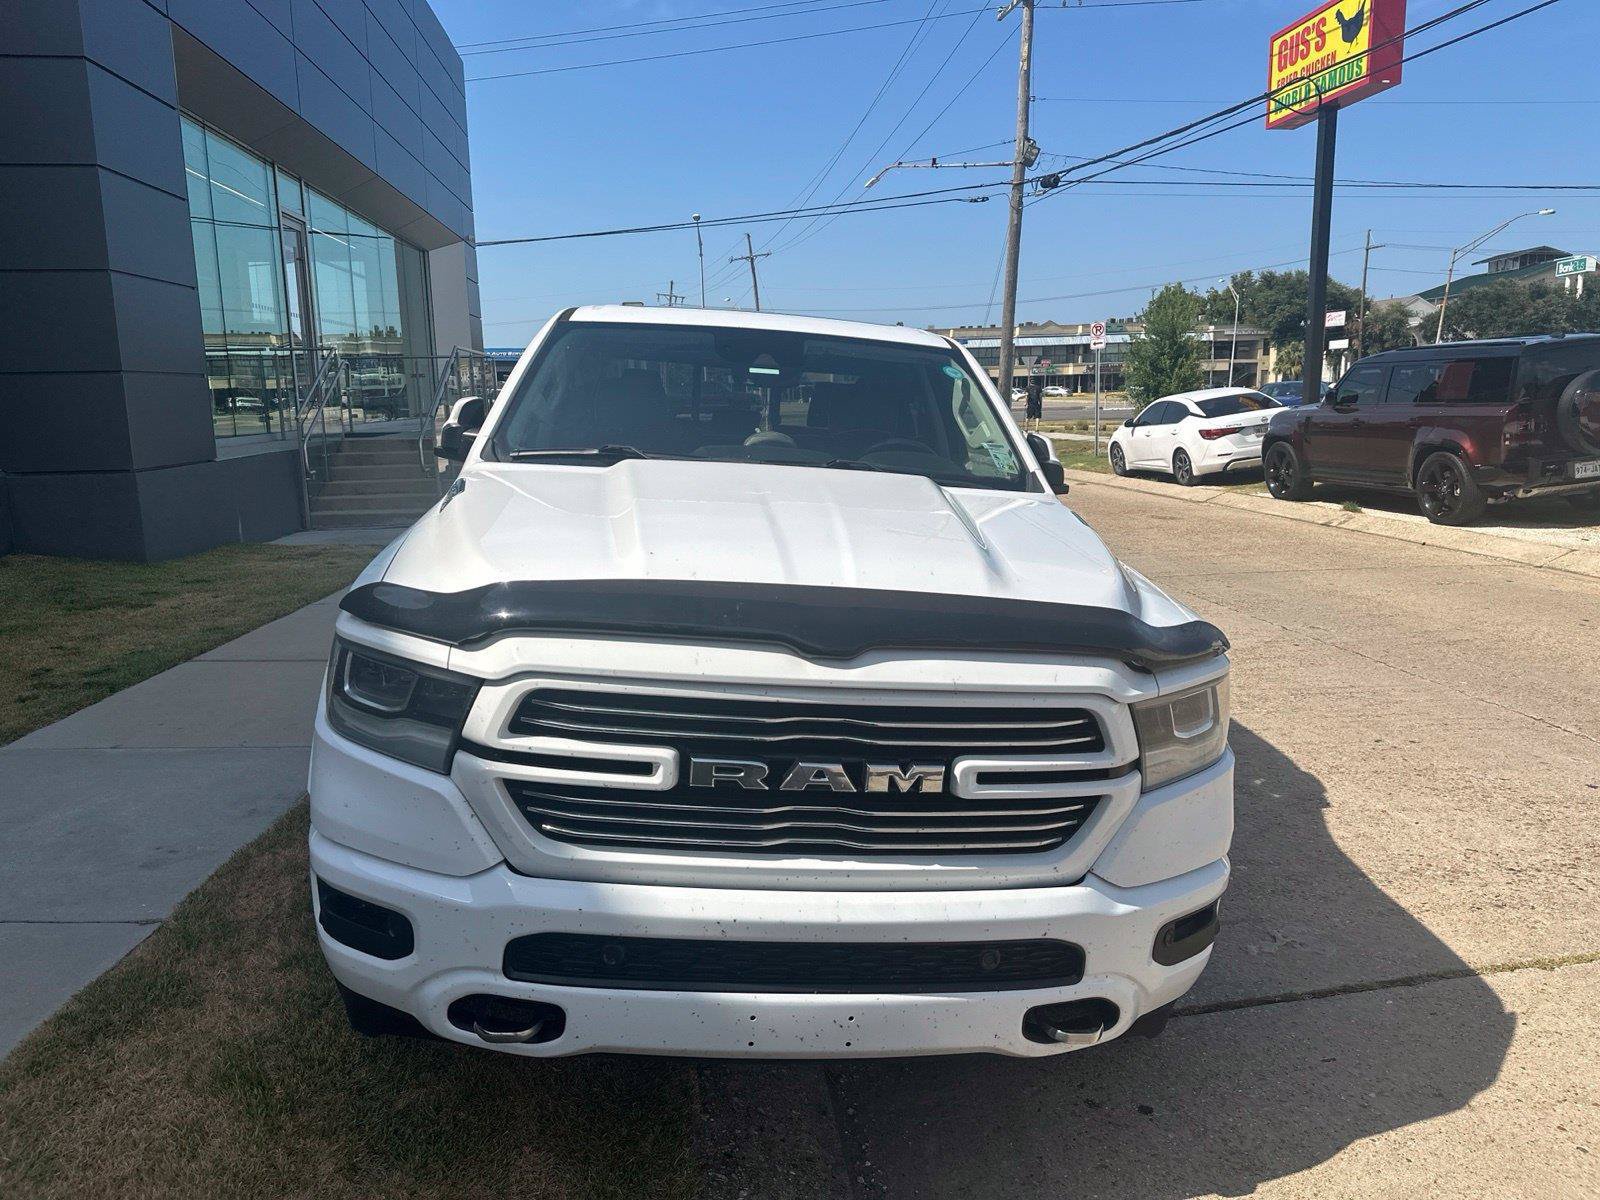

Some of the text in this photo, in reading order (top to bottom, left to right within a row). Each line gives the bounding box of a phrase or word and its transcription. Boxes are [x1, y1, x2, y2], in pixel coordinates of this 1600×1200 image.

[1277, 17, 1327, 73] GUS'S
[1300, 50, 1337, 78] CHICKEN
[1274, 58, 1363, 115] WORLD FAMOUS
[689, 757, 945, 793] RAM
